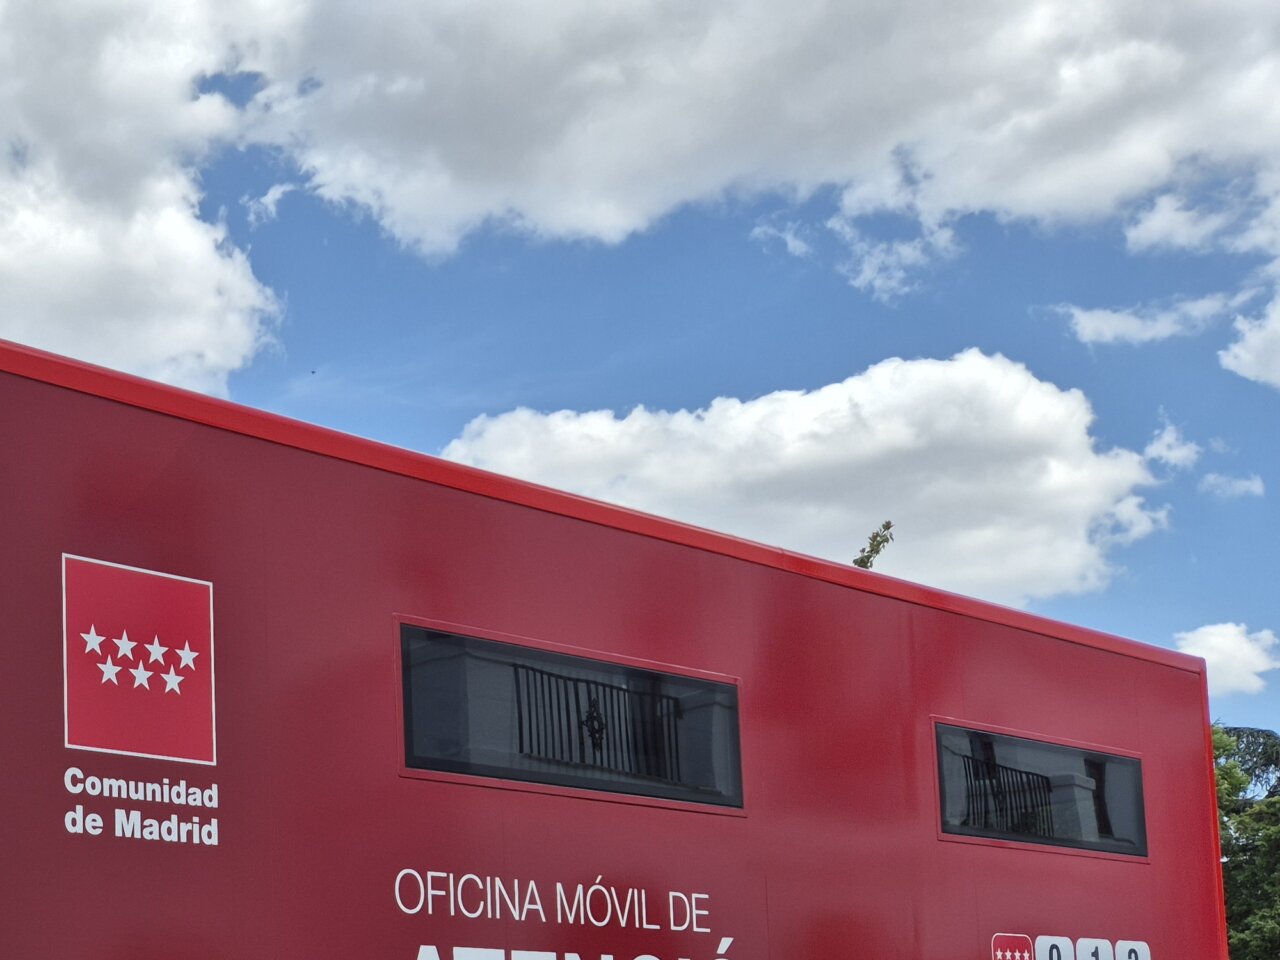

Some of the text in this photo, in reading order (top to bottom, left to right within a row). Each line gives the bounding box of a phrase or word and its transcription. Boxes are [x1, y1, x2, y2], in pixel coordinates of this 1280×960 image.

[64, 767, 219, 808] Comunidad
[65, 805, 219, 846] de Madrid
[394, 868, 711, 933] OFICINA MÓVIL DE
